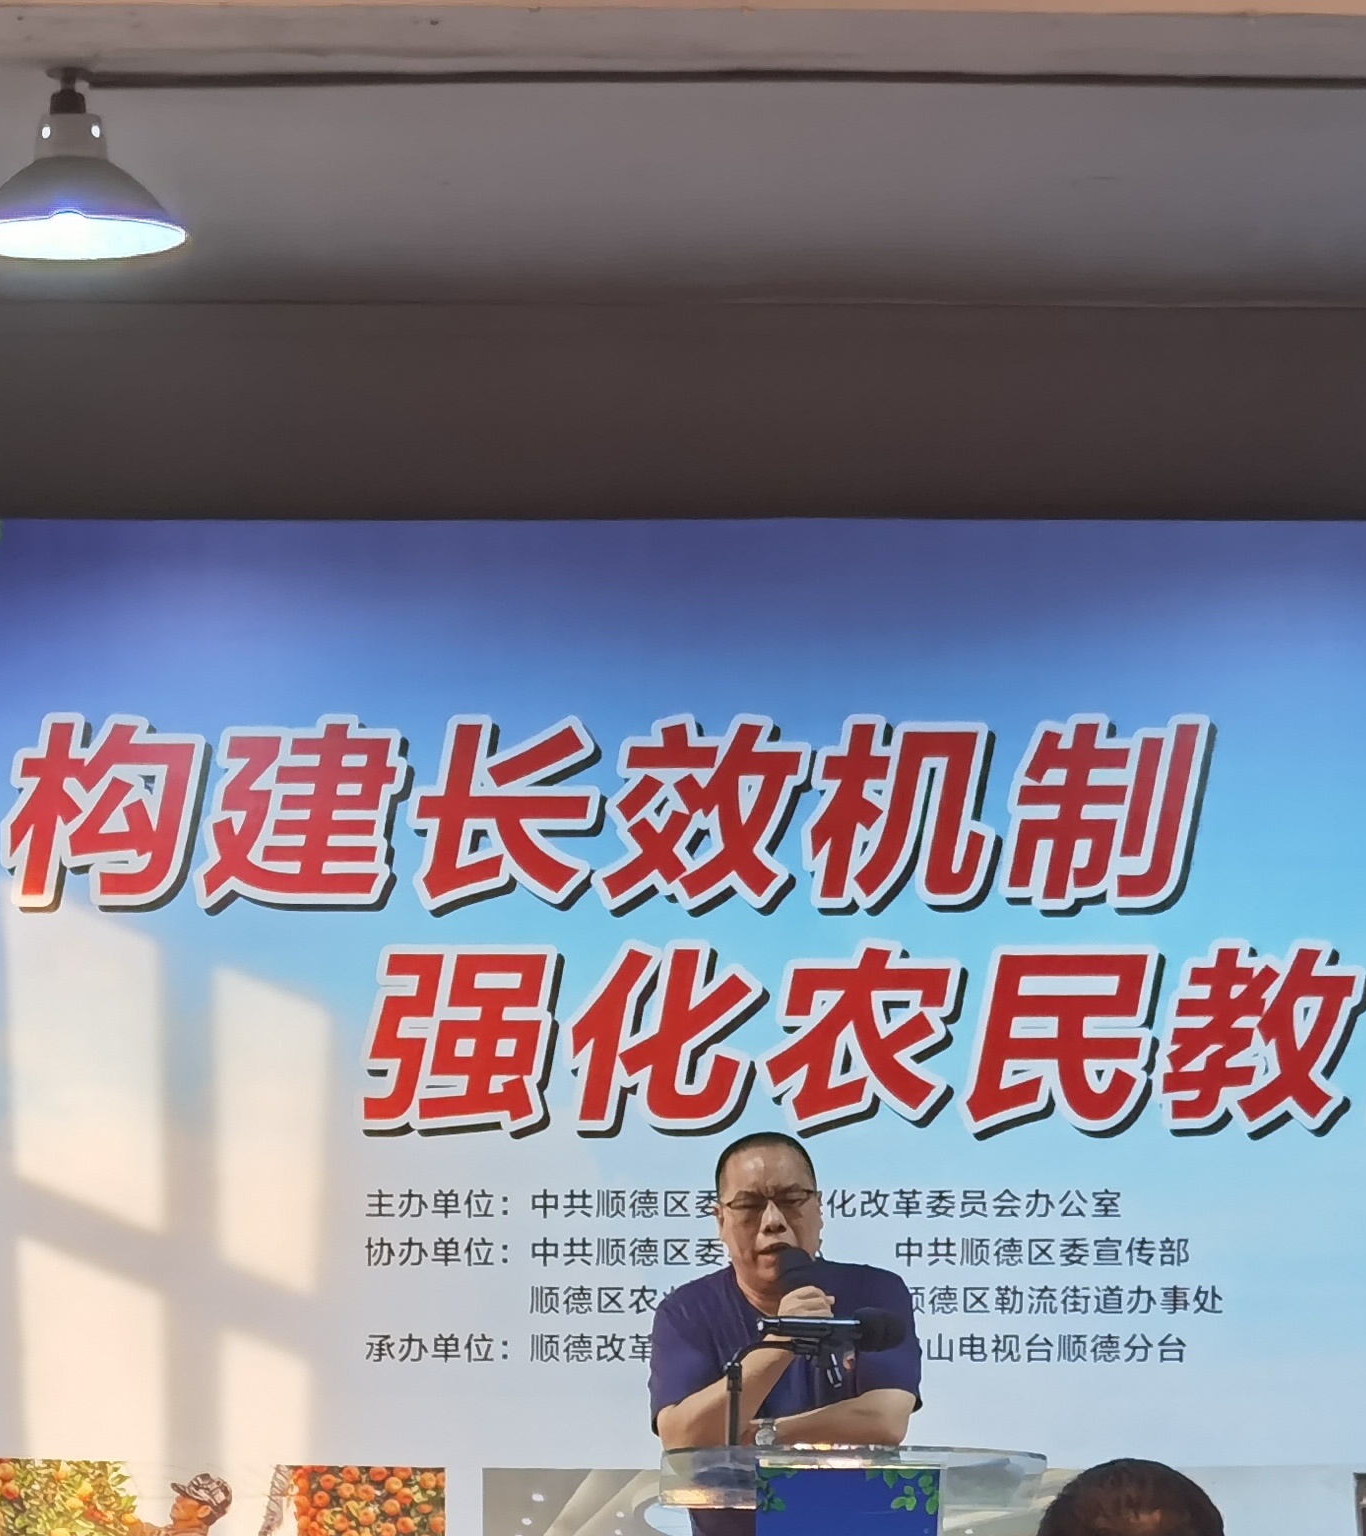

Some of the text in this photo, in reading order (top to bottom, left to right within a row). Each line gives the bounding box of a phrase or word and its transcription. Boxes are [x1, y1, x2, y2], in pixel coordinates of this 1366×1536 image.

[1, 711, 1218, 914] 构建长效机制
[895, 1237, 1190, 1267] 中共顺德区委宣传部
[530, 1286, 677, 1314] 顺德区农
